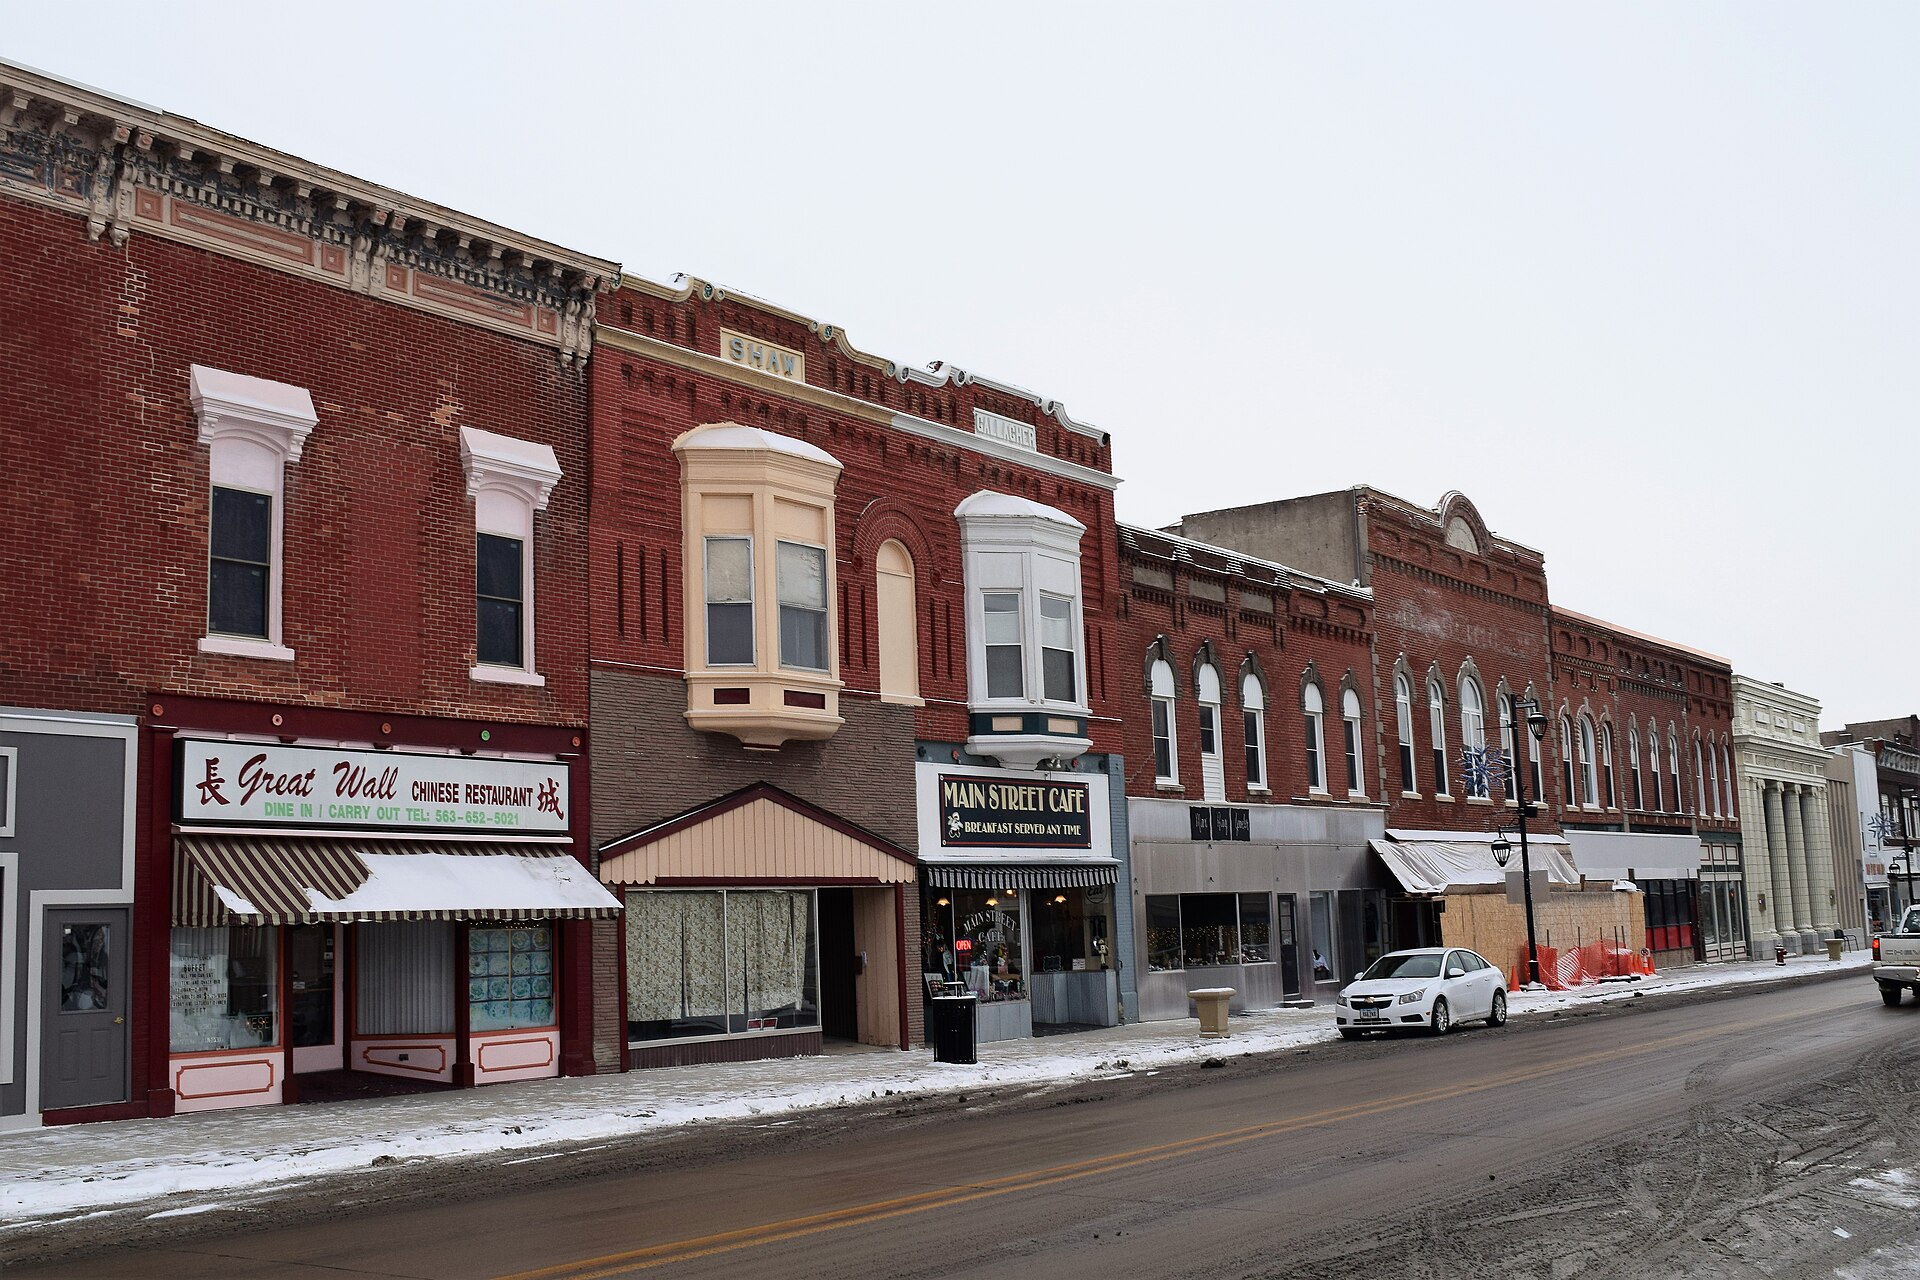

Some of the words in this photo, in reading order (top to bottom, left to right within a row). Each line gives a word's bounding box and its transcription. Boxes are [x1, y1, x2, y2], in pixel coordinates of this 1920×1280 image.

[729, 338, 795, 376] SHAW
[977, 414, 1034, 448] GALLAGHER
[196, 757, 230, 806] 長
[238, 753, 316, 806] Great
[333, 761, 399, 800] Wall
[411, 780, 460, 804] CHINESE
[465, 783, 533, 807] RESTAURANT
[537, 777, 565, 821] 城
[944, 781, 985, 809] MAIN
[989, 784, 1045, 811] STREET
[1049, 788, 1085, 813] CAFE
[264, 802, 294, 817] DINE
[300, 804, 313, 818] IN
[328, 805, 370, 820] CARRY
[376, 807, 400, 821] OUT
[406, 808, 430, 822] TEL:
[435, 810, 519, 825] 563-652-5021
[965, 821, 1013, 834] BREAKFAST
[1014, 822, 1045, 834] SERVED
[1047, 824, 1062, 835] ANY
[1063, 825, 1081, 836] TIME
[963, 912, 984, 932] MAIN
[985, 910, 1017, 931] STREET
[956, 940, 972, 951] OPEN
[184, 963, 206, 972] BUFFET
